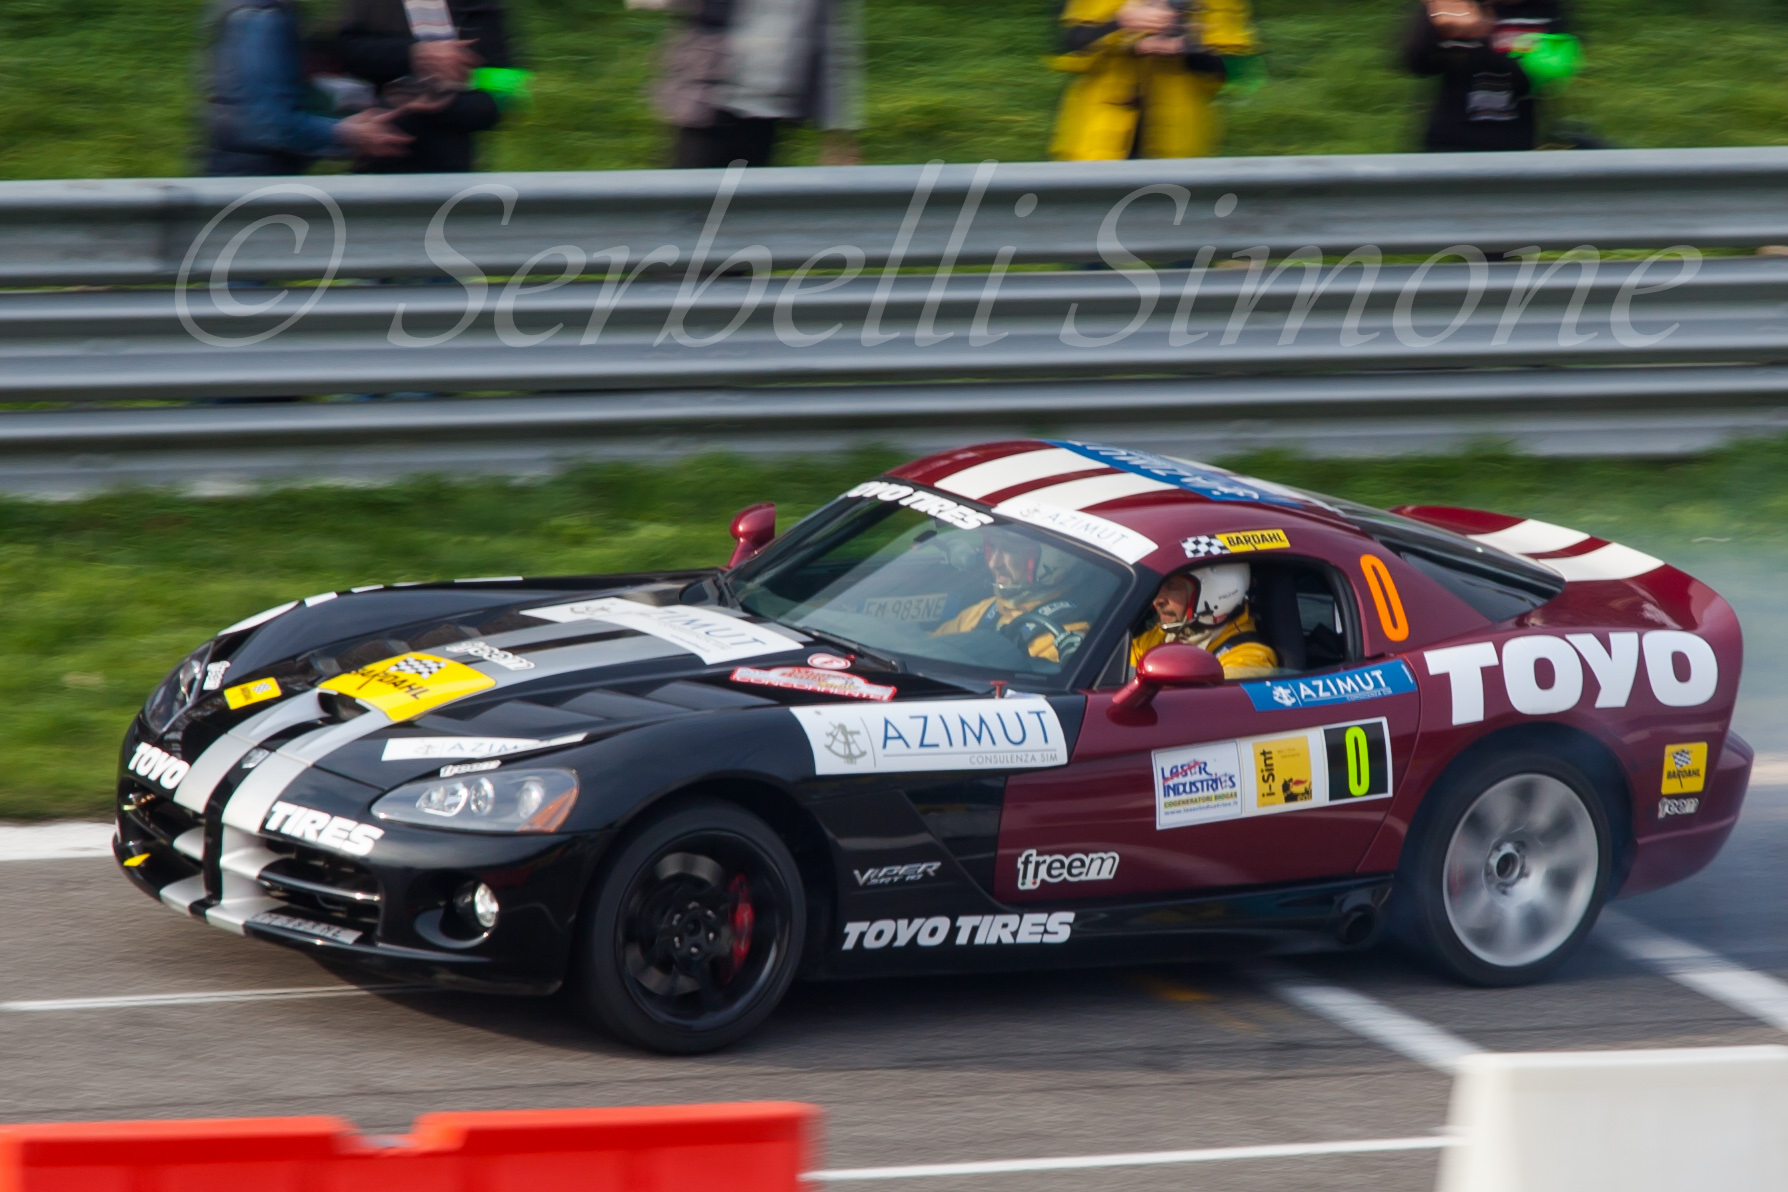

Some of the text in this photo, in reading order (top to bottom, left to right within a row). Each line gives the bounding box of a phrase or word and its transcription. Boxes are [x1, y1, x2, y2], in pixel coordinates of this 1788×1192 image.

[899, 490, 994, 530] TIRES
[1048, 512, 1128, 544] AZIMUT
[1226, 532, 1286, 548] BARDAHL
[1360, 554, 1409, 641] 0
[1299, 670, 1387, 699] AZIMUT
[1423, 630, 1718, 725] TOYO
[882, 710, 1050, 749] AZIMUT
[128, 742, 190, 790] TOYO
[969, 753, 1058, 765] CONSULENZA SIM
[1345, 726, 1370, 796] 0
[265, 801, 385, 856] TIRES
[853, 861, 941, 888] VIPER
[1019, 850, 1118, 888] freem
[841, 912, 1075, 951] TOYO TIRES
